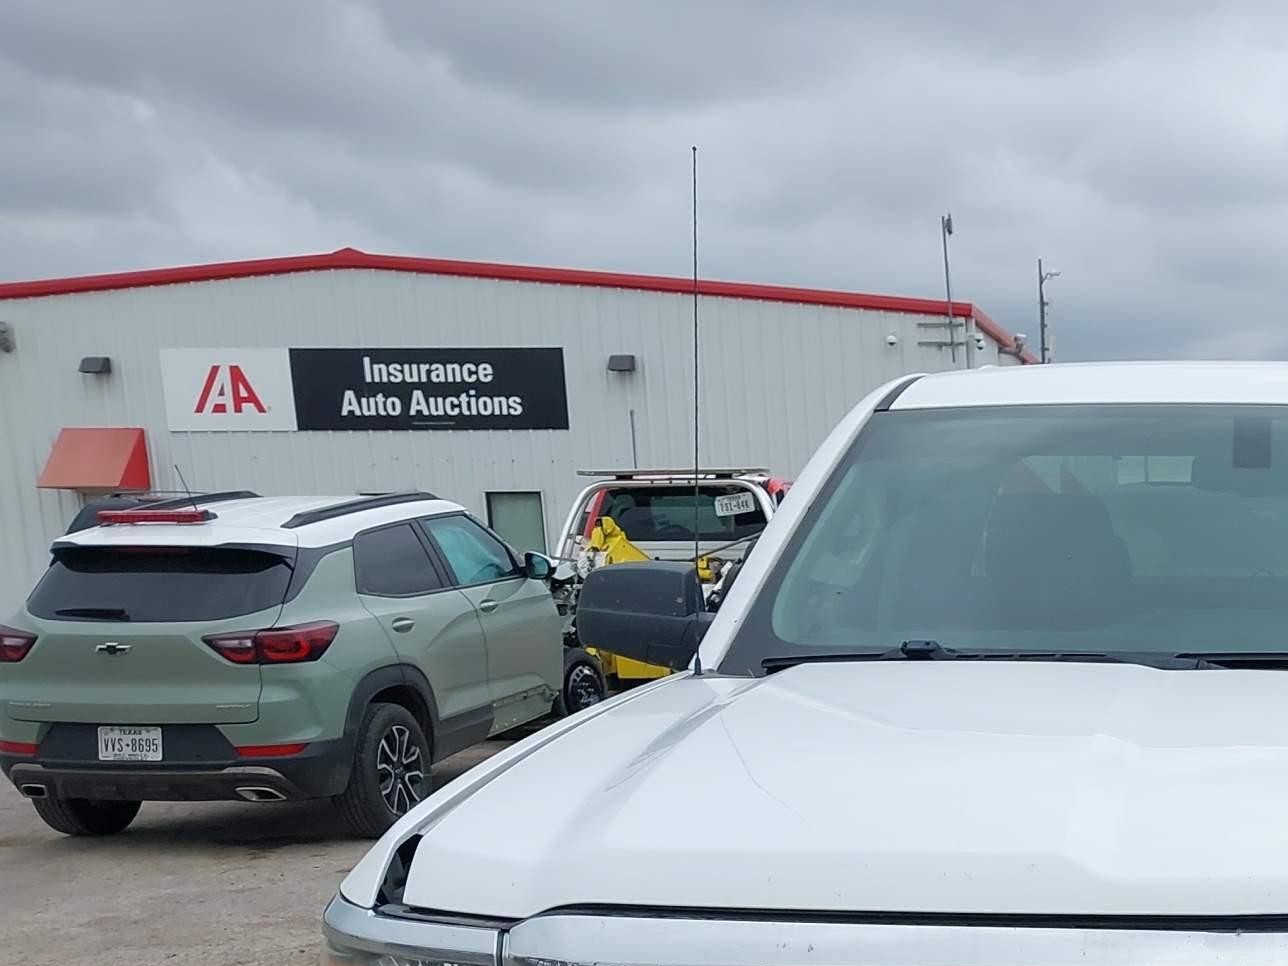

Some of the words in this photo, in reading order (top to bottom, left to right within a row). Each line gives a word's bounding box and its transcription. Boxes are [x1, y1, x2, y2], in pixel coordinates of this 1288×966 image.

[363, 356, 494, 383] Insurance
[341, 390, 402, 416] Auto
[409, 389, 523, 416] Auctions
